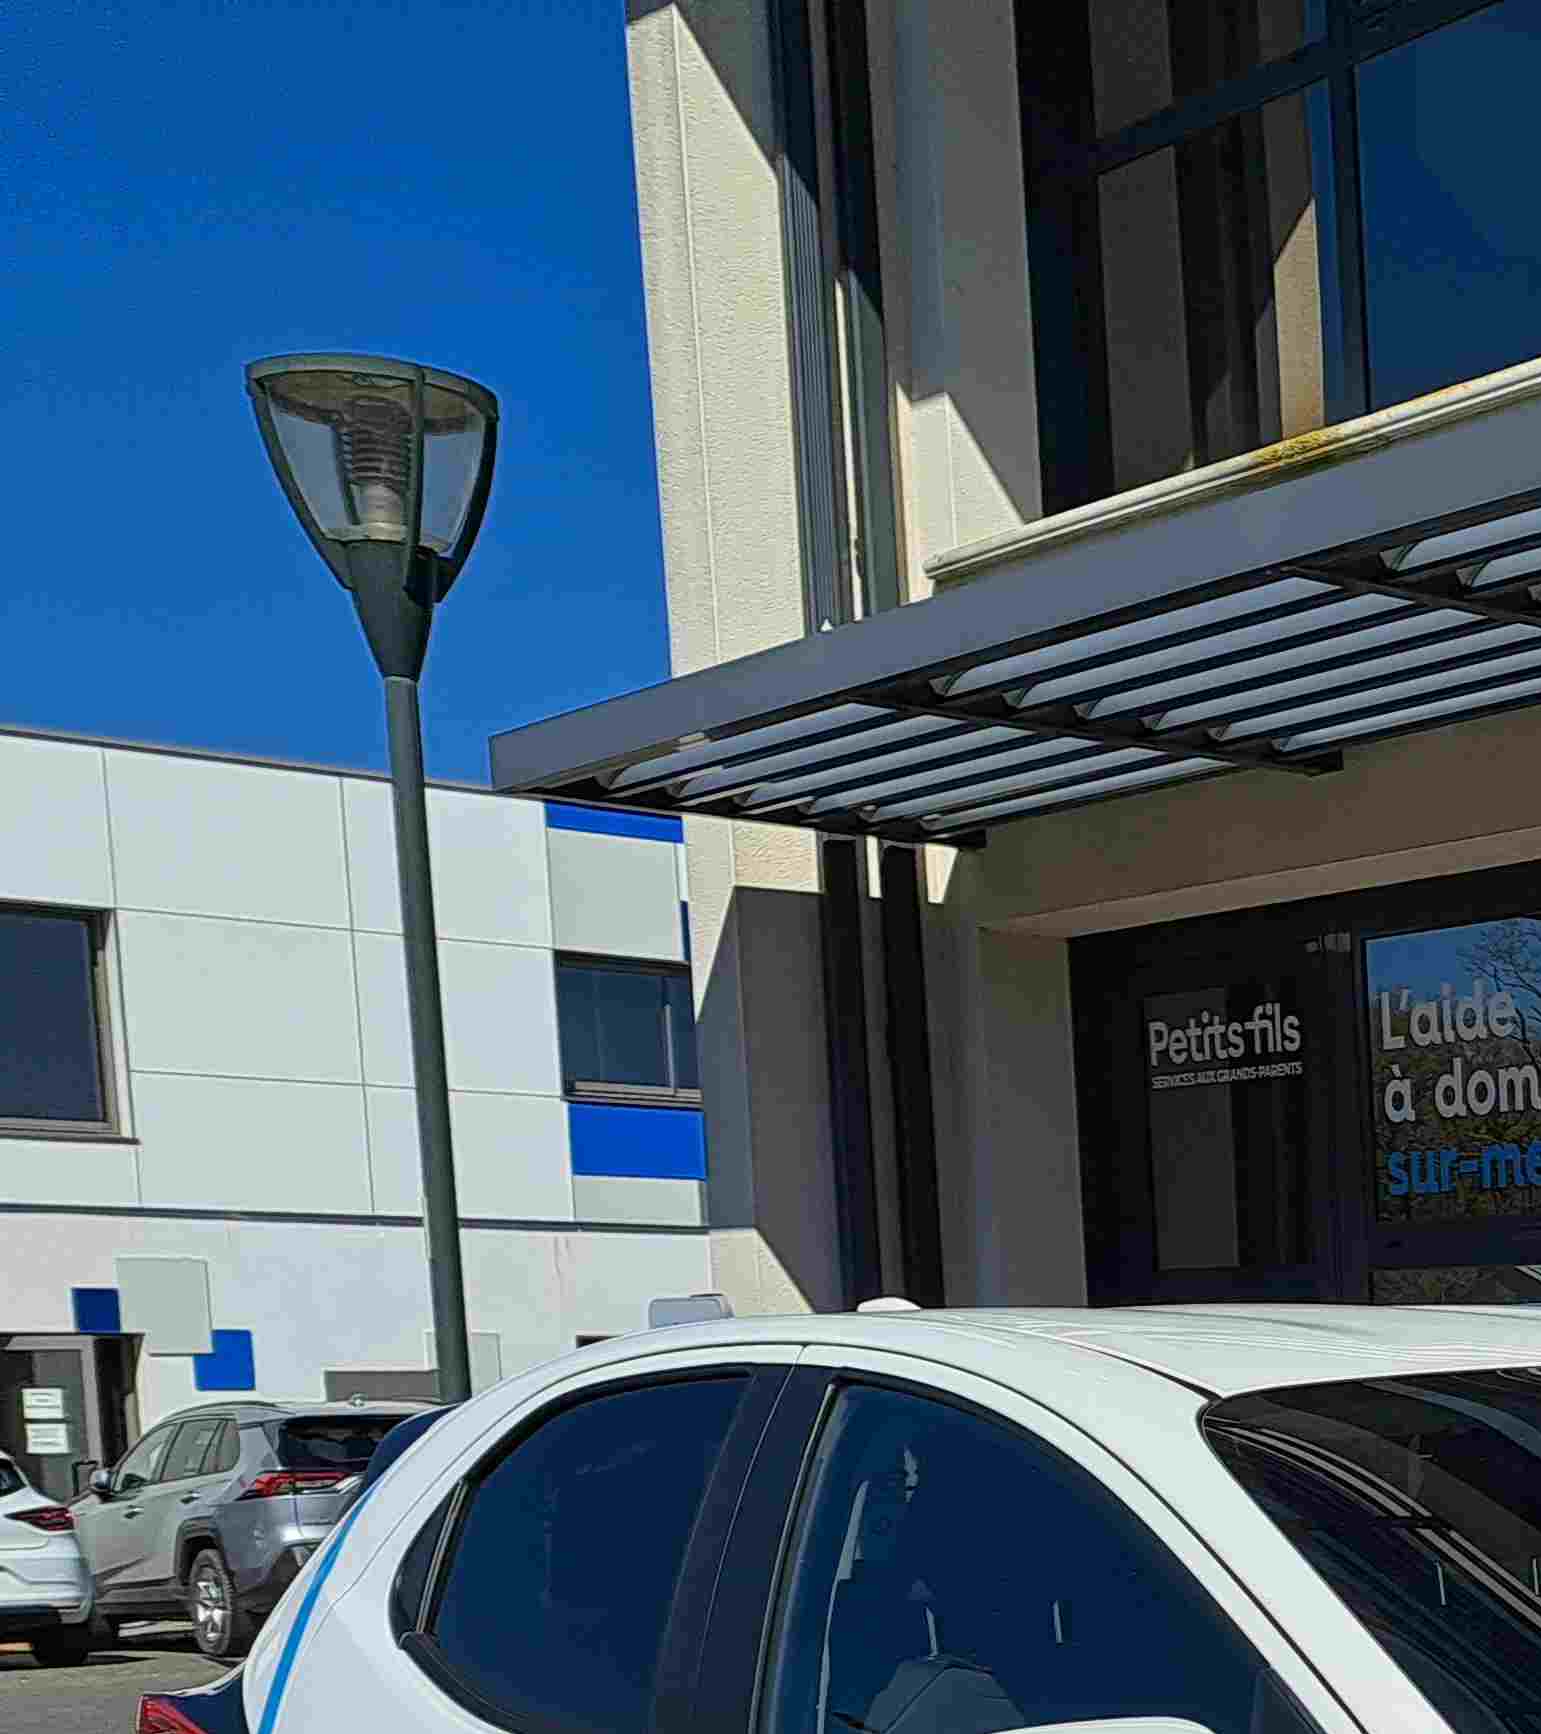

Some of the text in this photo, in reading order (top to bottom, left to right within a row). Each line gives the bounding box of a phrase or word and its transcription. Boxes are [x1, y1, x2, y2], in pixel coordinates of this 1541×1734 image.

[1381, 983, 1517, 1052] L'aide
[1152, 1062, 1303, 1090] SERVICES AUX GRANDS-PARENTS
[1384, 1064, 1416, 1124] à
